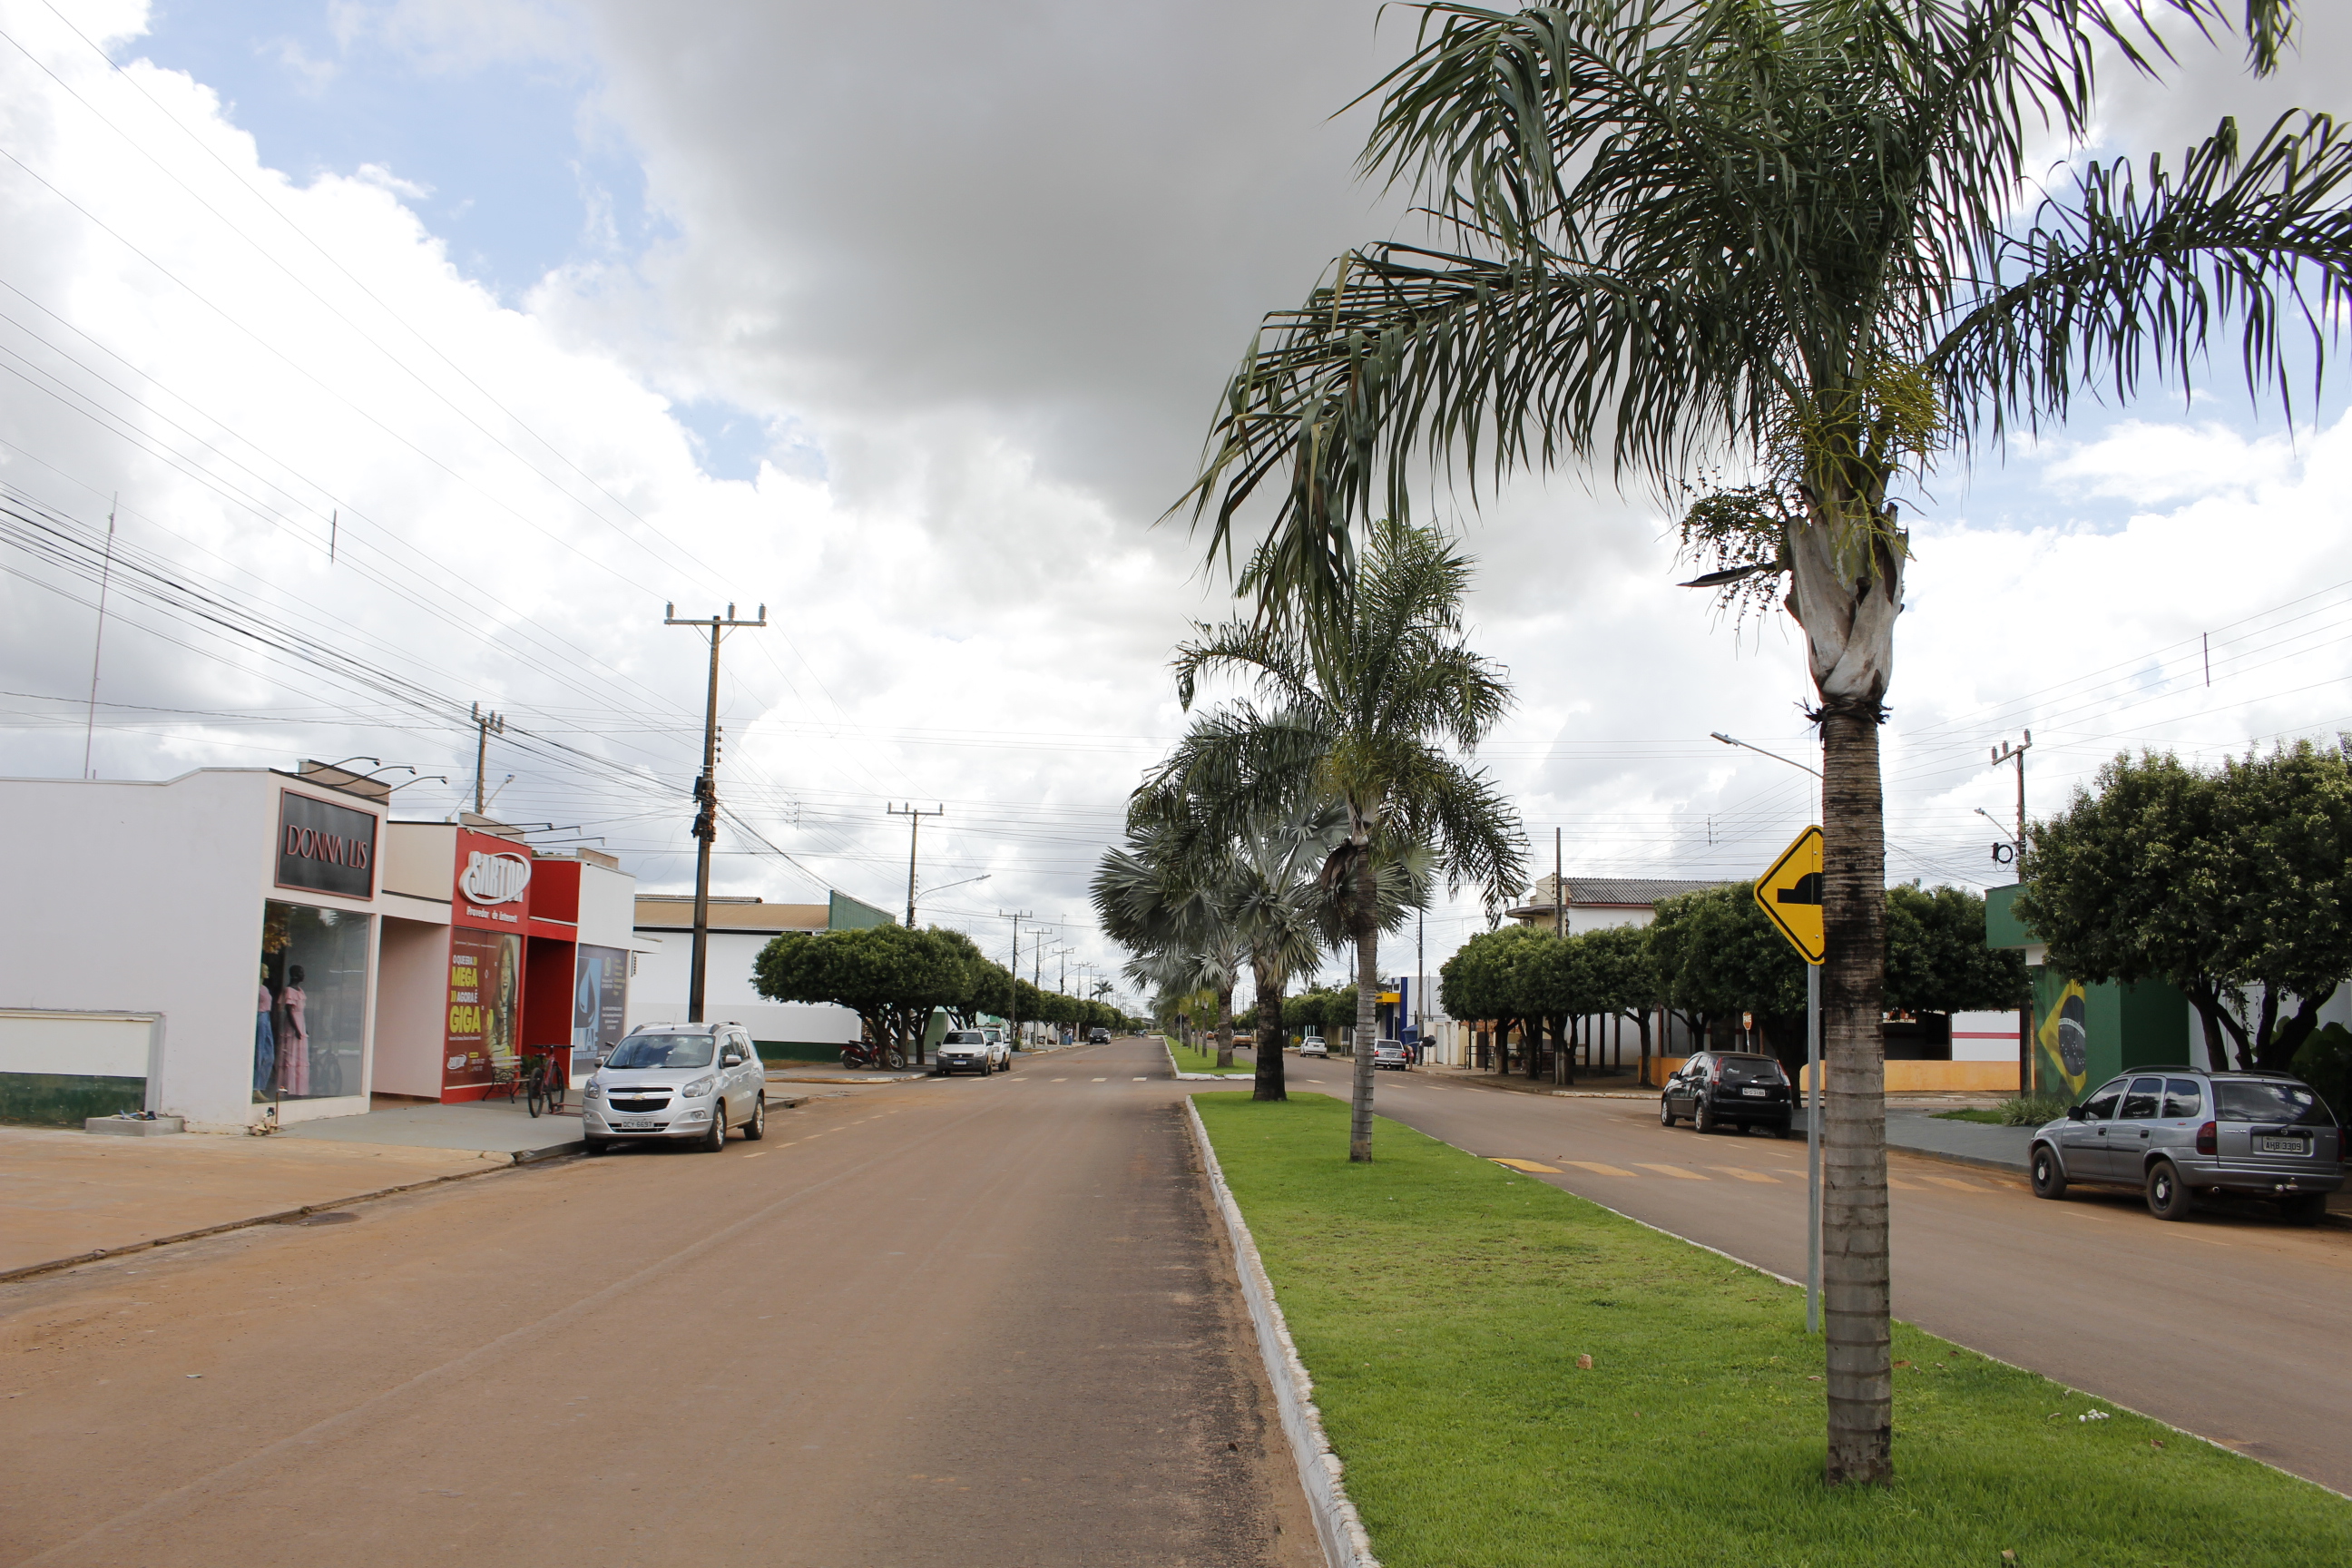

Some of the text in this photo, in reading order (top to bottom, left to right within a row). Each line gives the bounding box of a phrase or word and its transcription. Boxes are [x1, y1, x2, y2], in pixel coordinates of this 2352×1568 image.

[285, 824, 368, 869] DONNA LIS
[468, 851, 525, 902] SARTOR
[466, 906, 490, 918] Provedor
[492, 910, 499, 920] de
[451, 966, 478, 987] MEGA
[449, 1005, 481, 1034] GIGA
